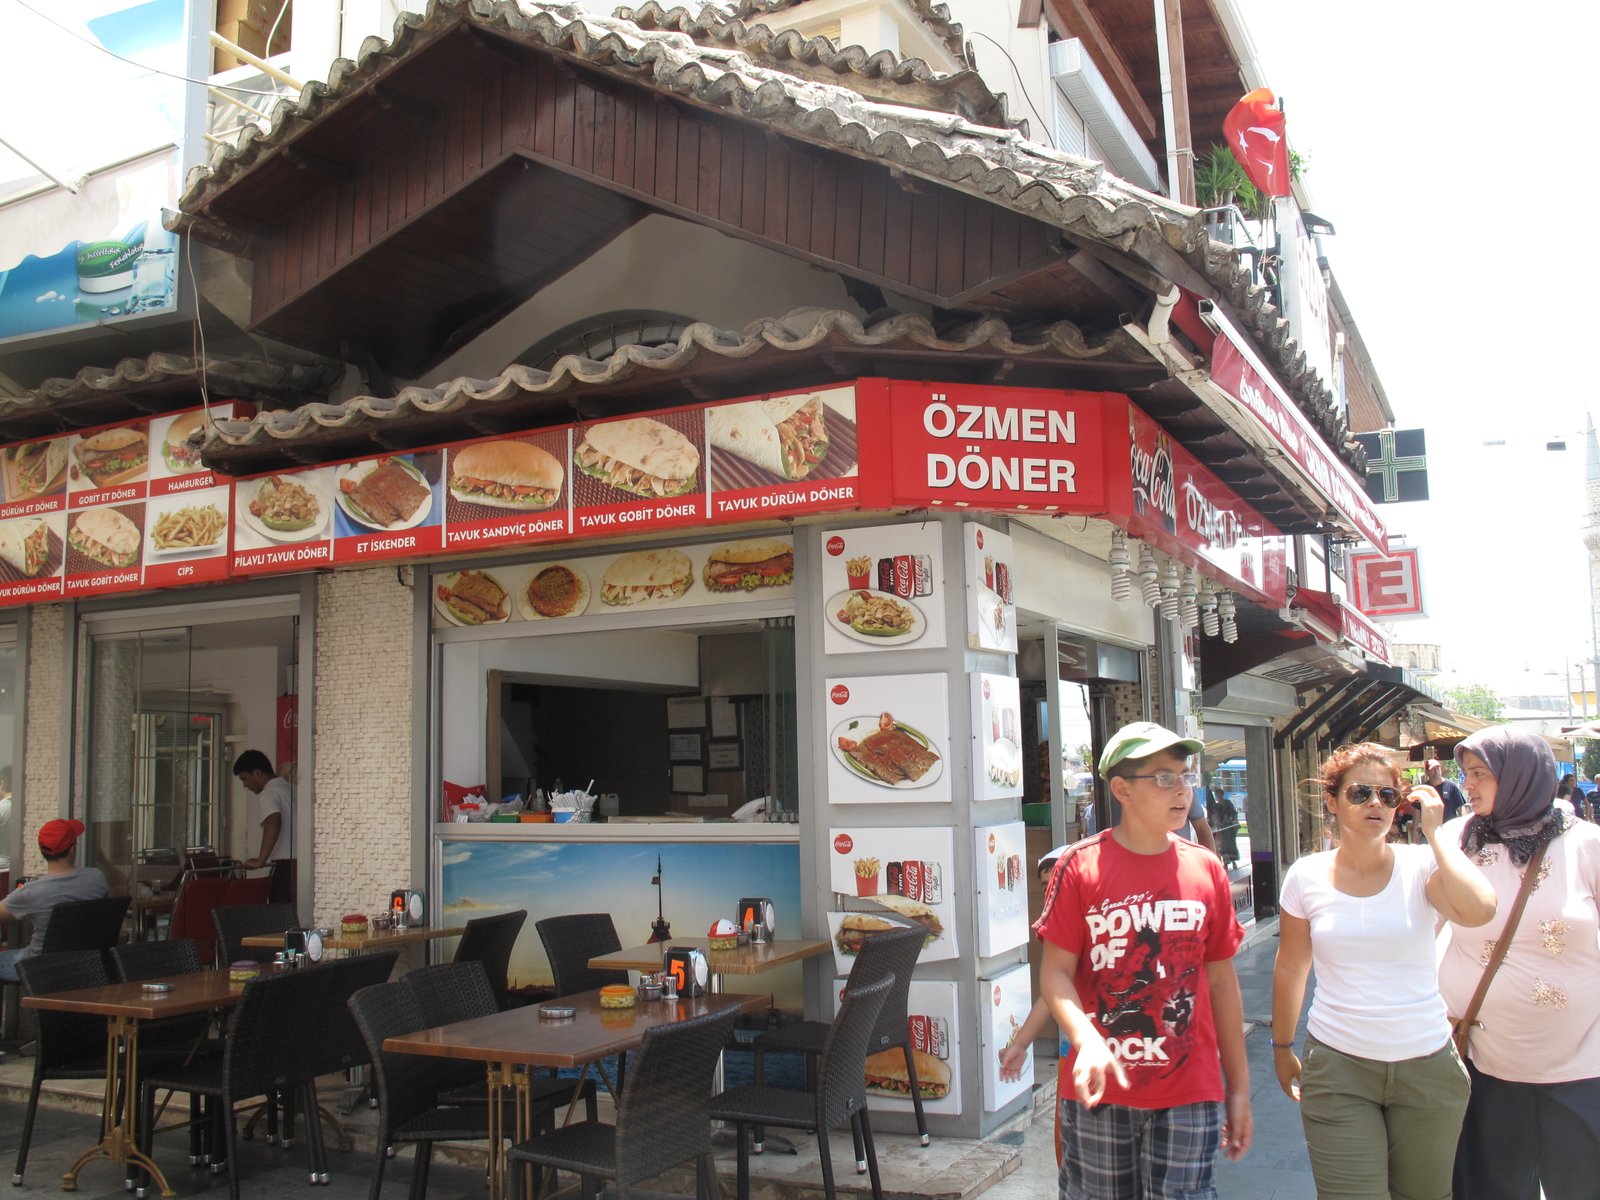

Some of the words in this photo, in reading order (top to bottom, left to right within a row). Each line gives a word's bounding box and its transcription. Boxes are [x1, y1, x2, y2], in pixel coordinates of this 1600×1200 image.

[923, 393, 1077, 444] ÖZMEN
[927, 445, 1077, 493] DÖNER
[1130, 436, 1177, 520] oca-Cola
[168, 476, 214, 491] HAMBURGER
[79, 493, 100, 504] GOBİT
[101, 492, 110, 501] ET
[111, 488, 136, 500] DÖNER
[718, 497, 758, 511] TAVUK
[761, 490, 806, 507] DÜRÜM
[810, 486, 854, 502] DÖNER
[1, 505, 25, 517] DÜRÜM
[26, 504, 34, 513] ET
[35, 501, 58, 512] DÖNER
[580, 513, 616, 527] TAVUK
[618, 507, 653, 522] GOBİT
[655, 504, 696, 519] DÖNER
[448, 529, 480, 542] TAVUK
[482, 521, 526, 540] SANDVİÇ
[528, 519, 564, 534] DÖNER
[357, 542, 369, 553] ET
[370, 536, 416, 551] İSKENDER
[234, 554, 265, 568] PİLAVLI
[267, 551, 295, 563] TAVUK
[297, 546, 328, 560] DÖNER
[67, 579, 89, 589] TAVUK
[91, 574, 112, 586] GOBİT
[114, 573, 138, 584] DÖNER
[177, 564, 194, 577] CİPS
[12, 585, 36, 595] DÜRÜM
[38, 582, 61, 592] DÖNER
[1365, 560, 1408, 608] E
[1085, 899, 1207, 945] POWER
[1090, 938, 1129, 972] OF
[670, 959, 685, 991] 5
[1105, 1036, 1171, 1061] OCK
